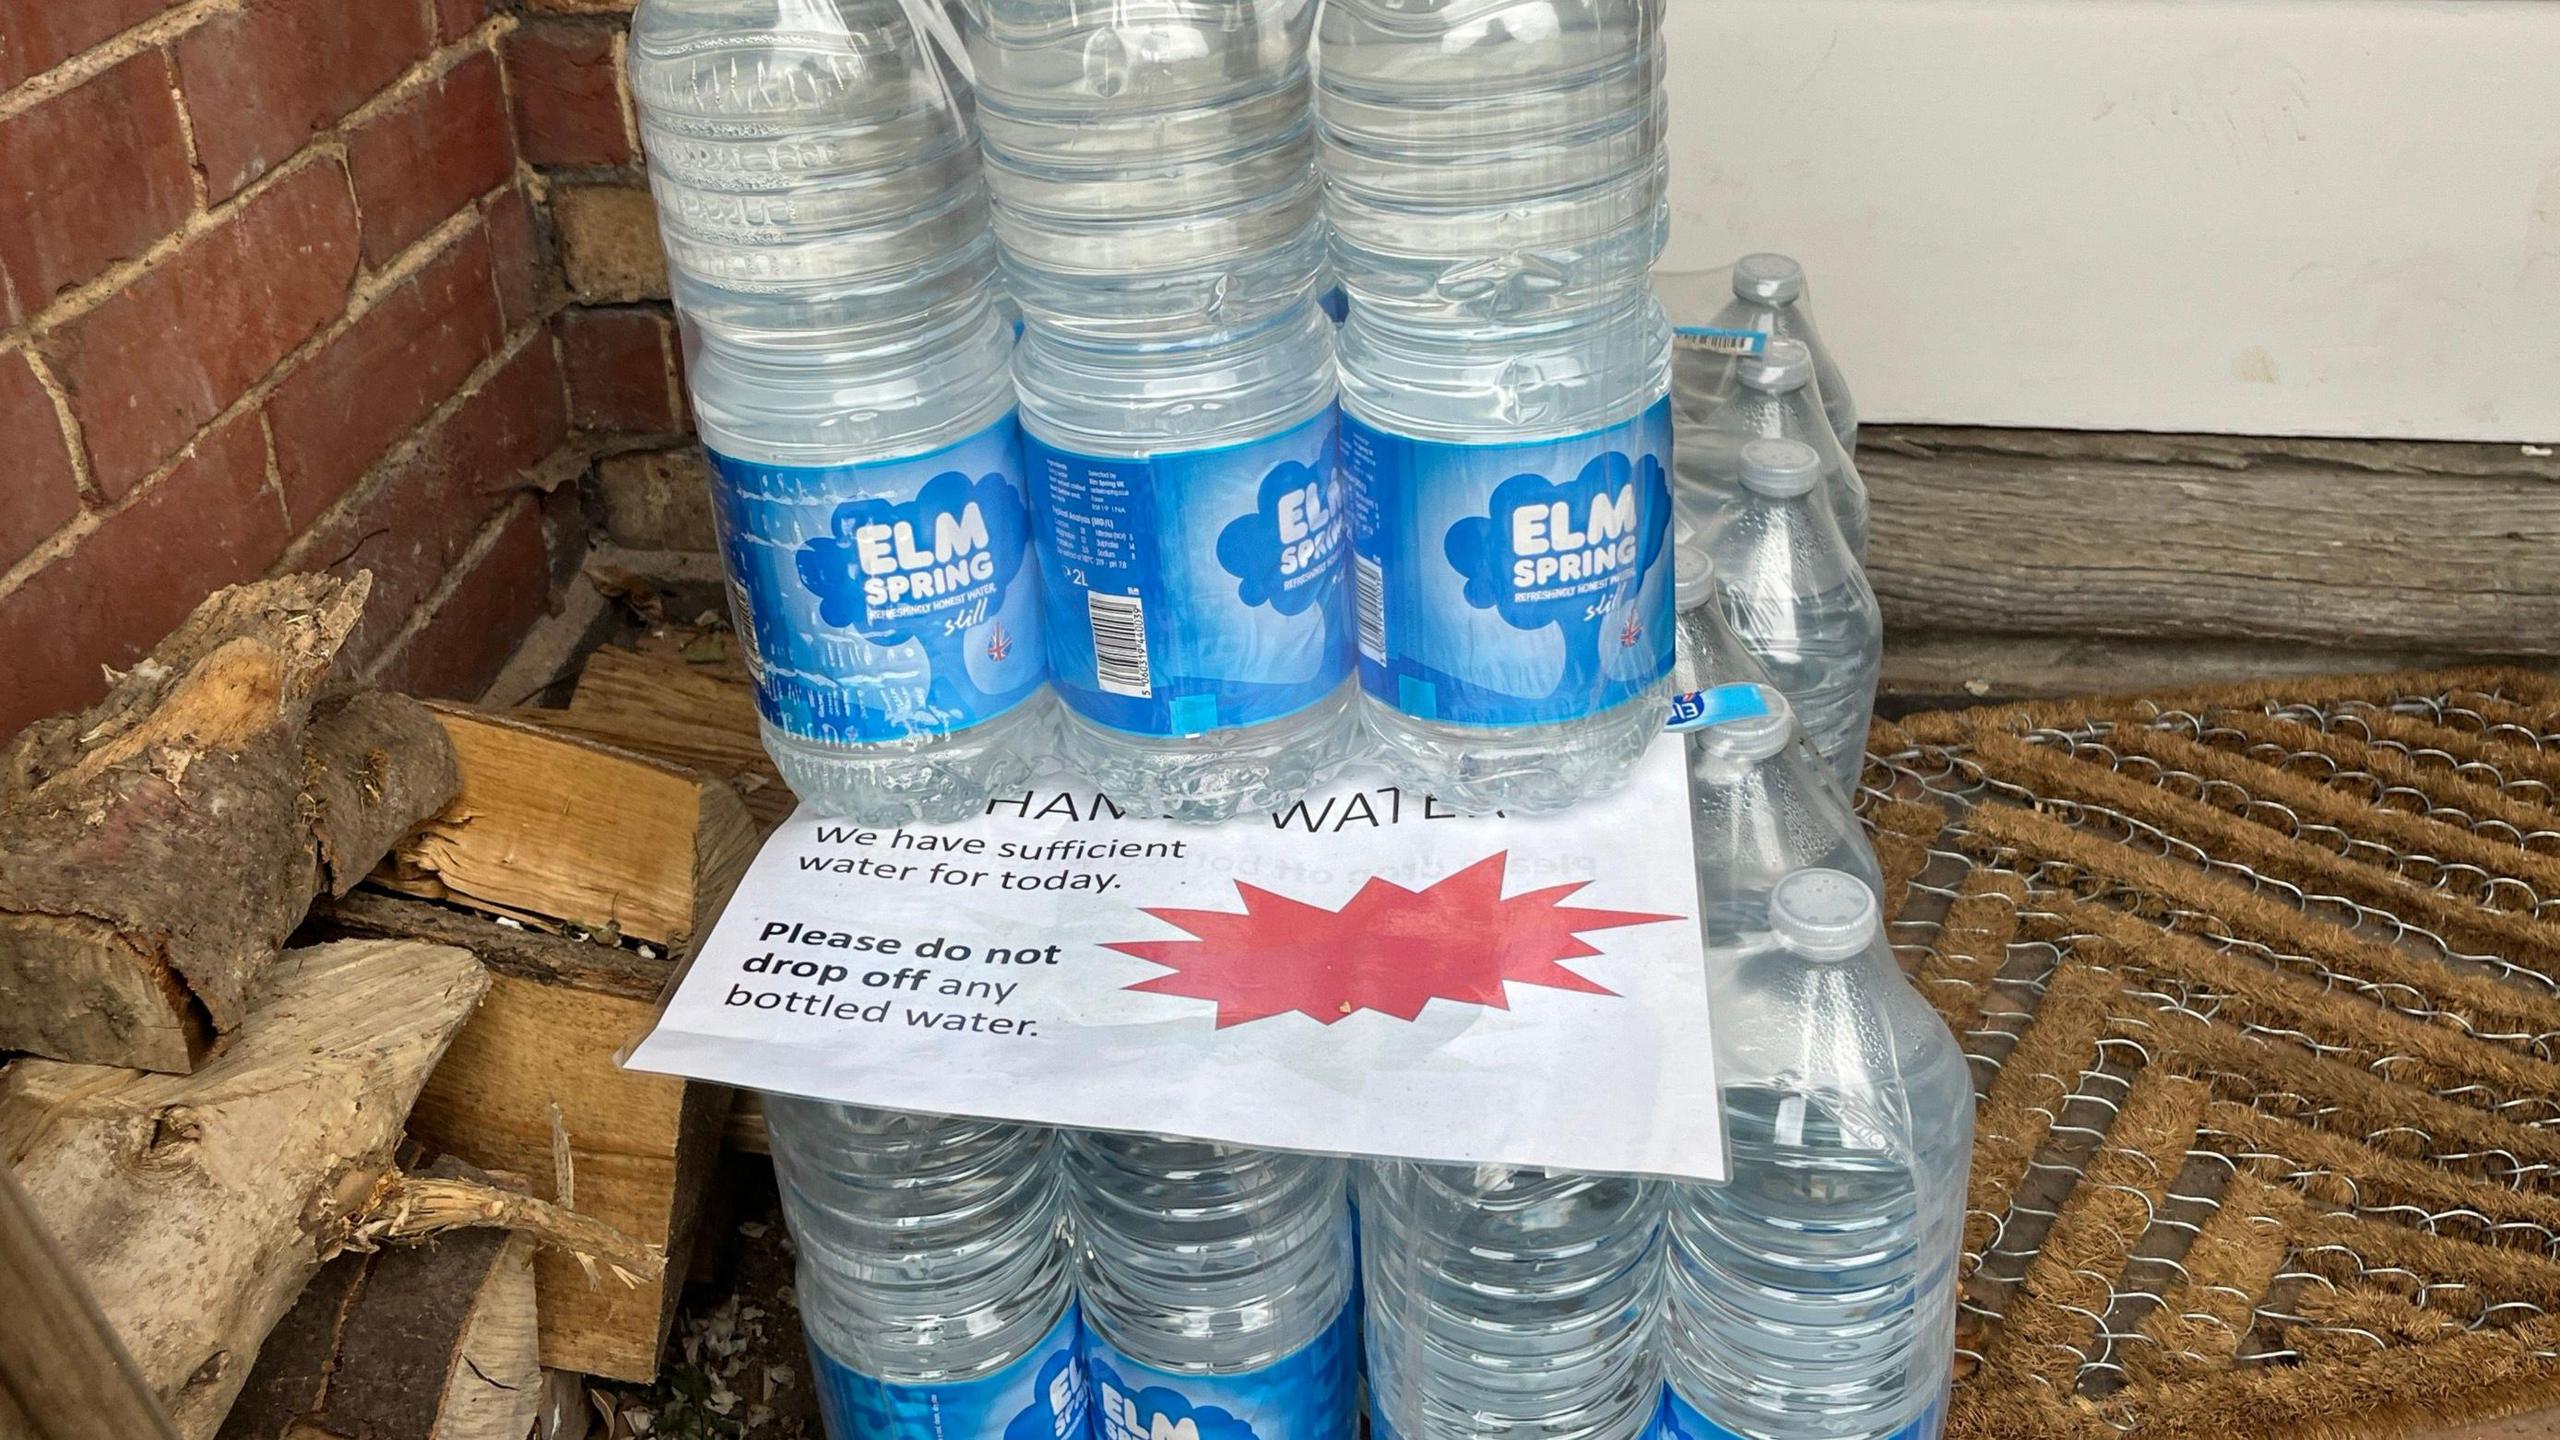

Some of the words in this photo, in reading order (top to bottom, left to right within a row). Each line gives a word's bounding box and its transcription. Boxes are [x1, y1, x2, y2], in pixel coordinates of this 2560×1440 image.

[857, 501, 990, 576] ELM
[1512, 484, 1637, 556] ELM
[864, 551, 994, 606] SPRING
[1073, 568, 1088, 587] 2L
[1513, 535, 1637, 588] SPRING
[944, 596, 988, 637] still
[1272, 786, 1506, 832] WATE
[817, 826, 878, 846] We
[891, 828, 986, 855] have
[997, 839, 1187, 861] sufficient
[799, 856, 918, 881] water
[929, 862, 989, 887] for
[1001, 869, 1121, 894] today.
[759, 922, 902, 955] Please
[915, 937, 972, 961] do
[985, 944, 1062, 965] not
[742, 952, 848, 986] drop
[862, 967, 932, 991] off
[938, 978, 1018, 1005] any
[724, 983, 892, 1023] bottled
[906, 1009, 1038, 1037] water.
